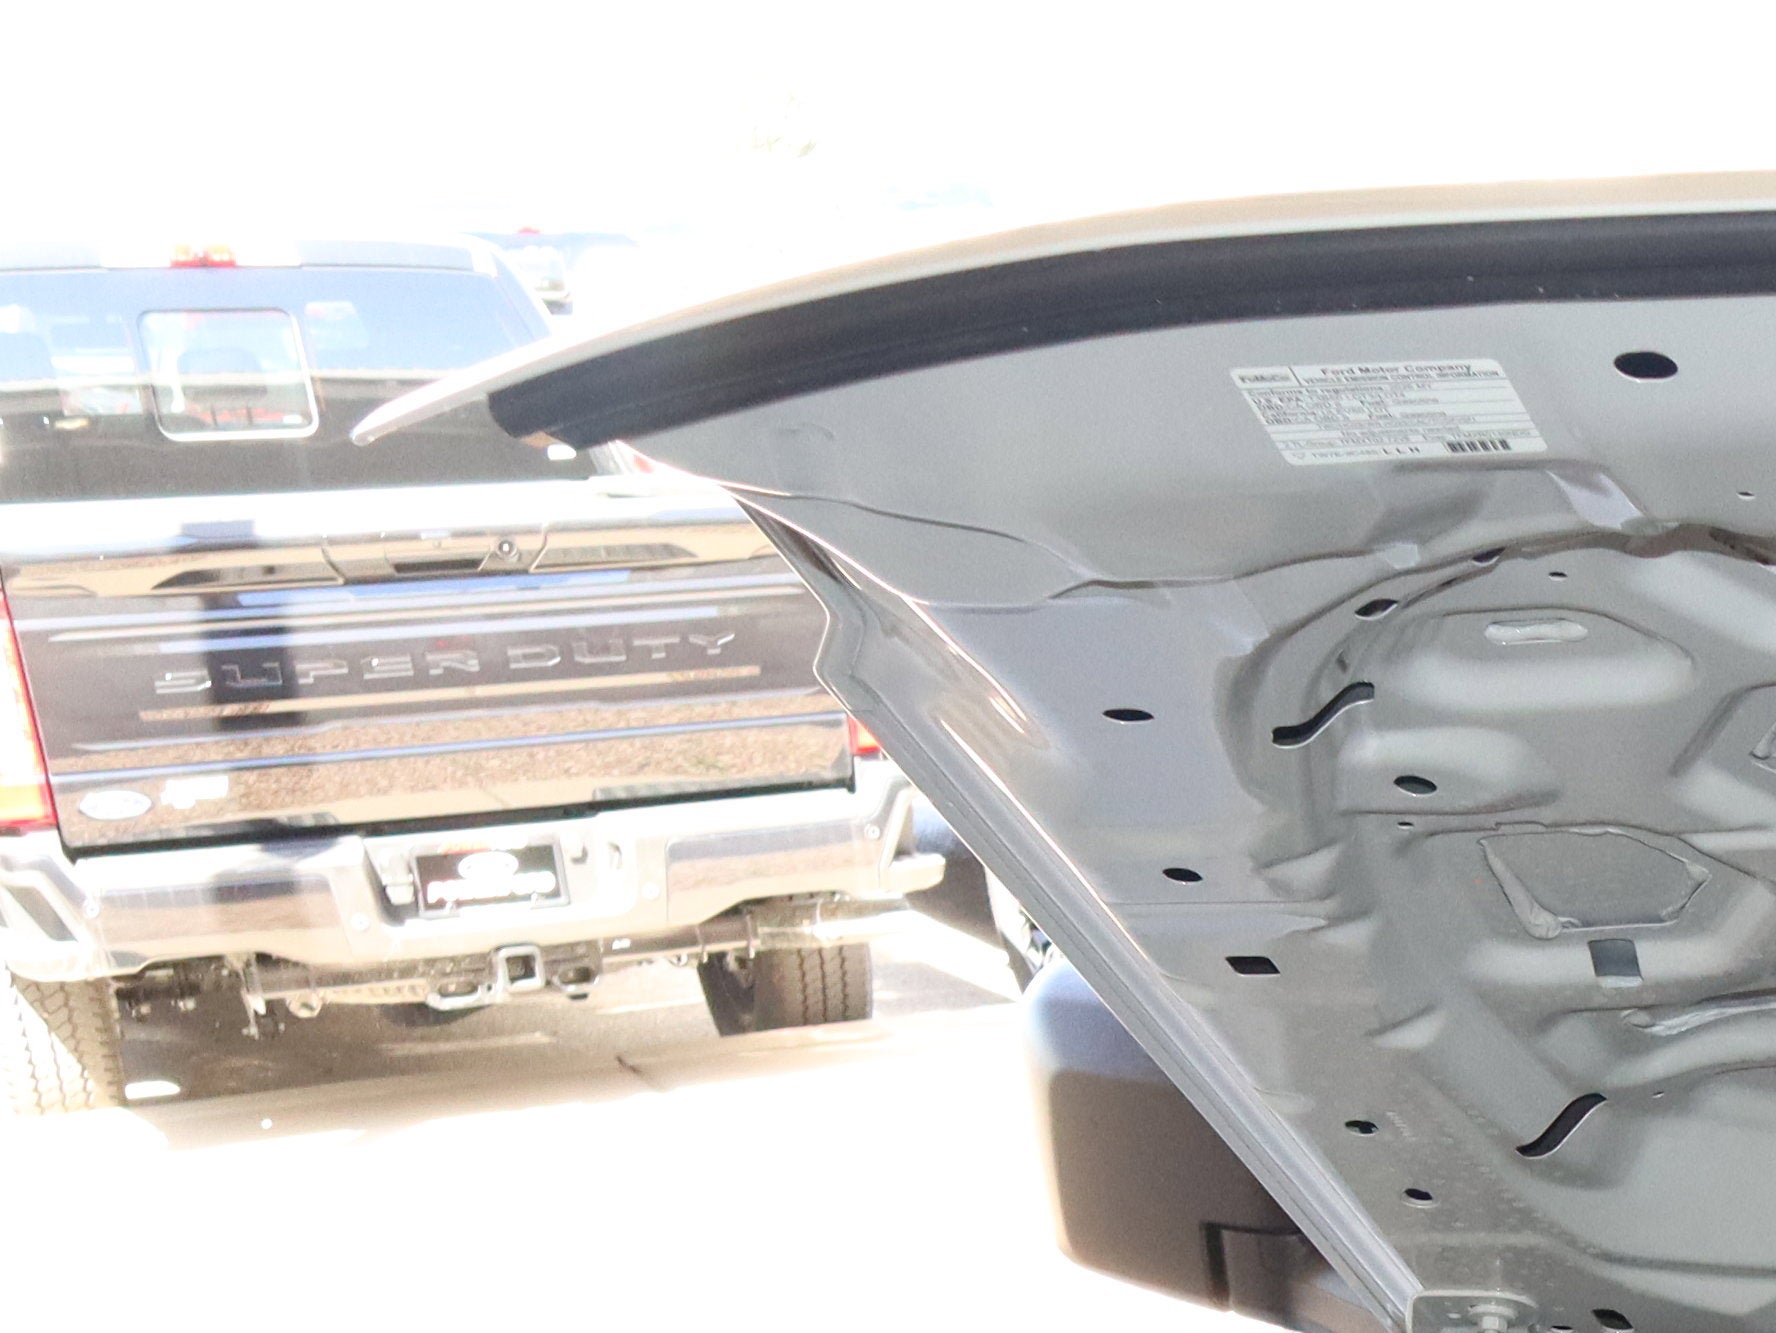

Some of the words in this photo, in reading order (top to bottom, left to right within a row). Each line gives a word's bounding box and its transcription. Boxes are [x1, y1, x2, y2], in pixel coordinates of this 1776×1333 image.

[1319, 367, 1356, 375] Ford
[1357, 365, 1398, 373] Motor
[1403, 363, 1476, 378] Company
[155, 650, 481, 694] SUPER
[507, 630, 736, 669] DUTY
